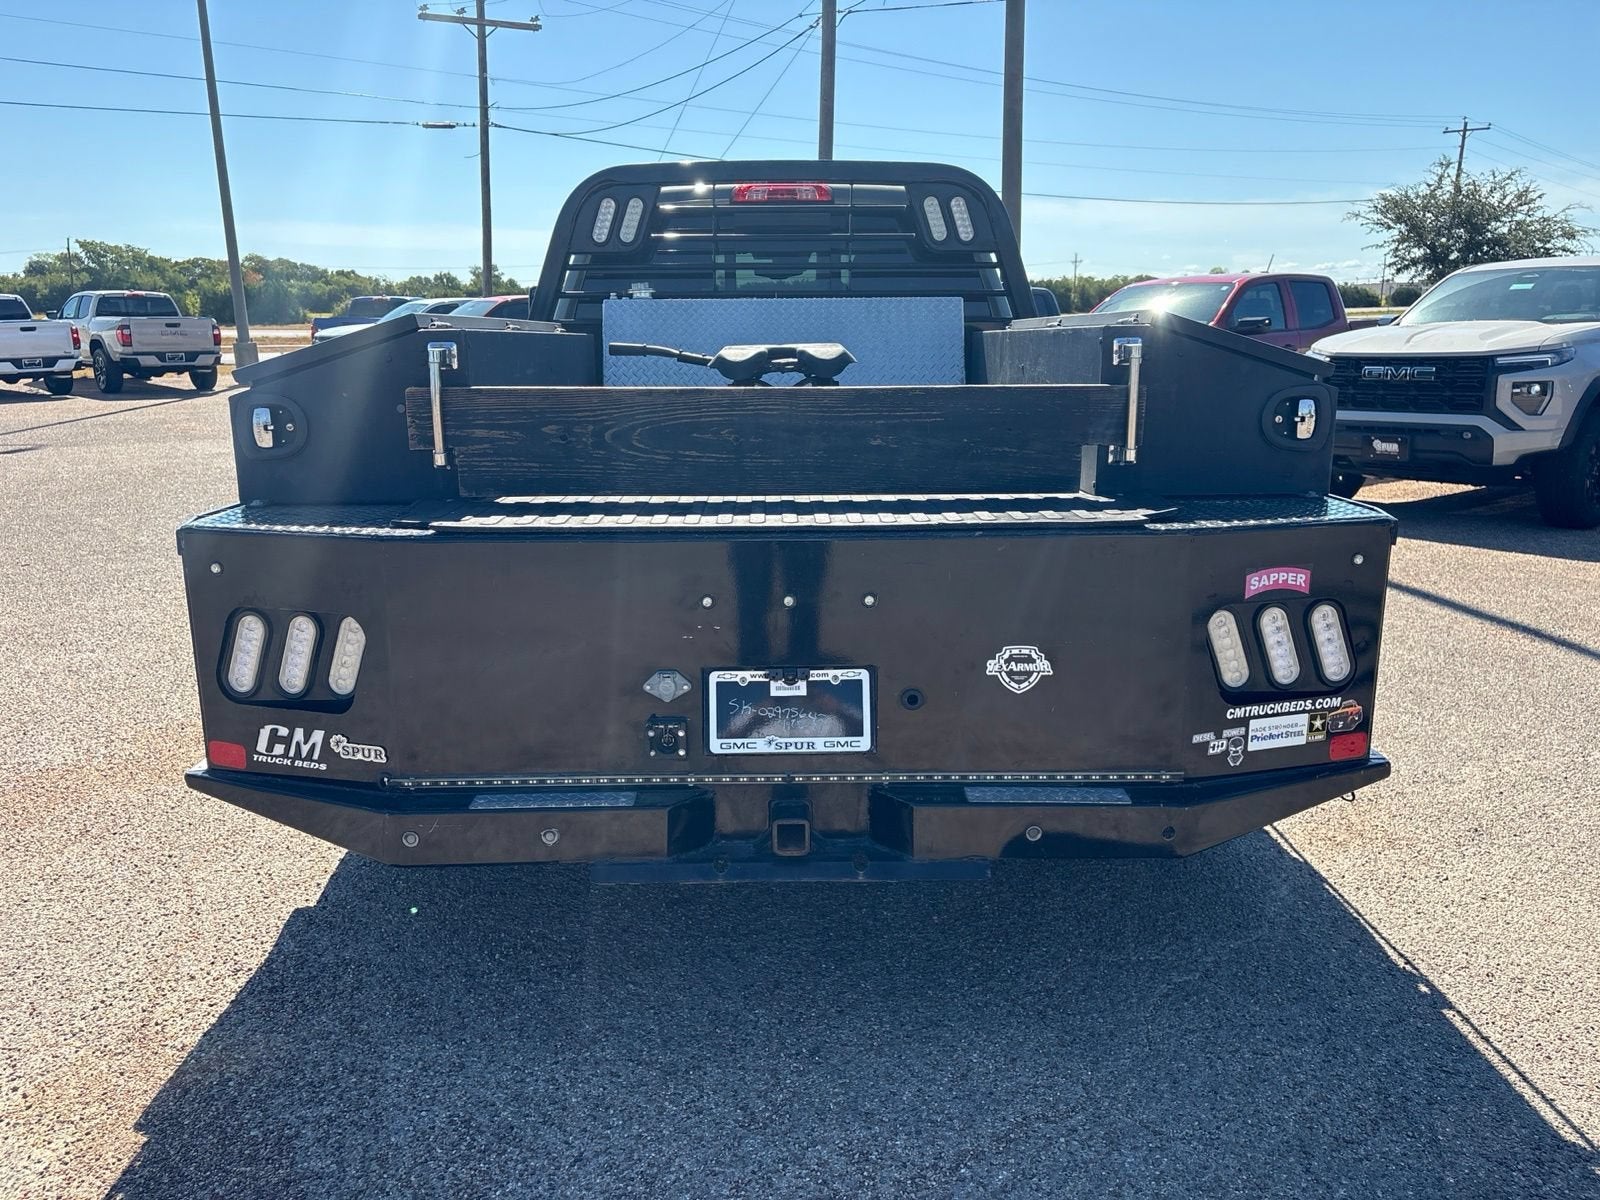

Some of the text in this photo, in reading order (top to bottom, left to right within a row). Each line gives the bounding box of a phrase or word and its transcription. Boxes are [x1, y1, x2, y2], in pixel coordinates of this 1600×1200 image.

[1361, 366, 1436, 381] GMC
[1249, 572, 1306, 590] SAPPER
[1226, 697, 1342, 719] CMTRUCKBEDS.COM
[256, 724, 325, 760] CM
[720, 740, 860, 750] GMC SPUR GMC
[341, 745, 384, 760] SPUR
[253, 754, 328, 770] TRUCK BEDS
